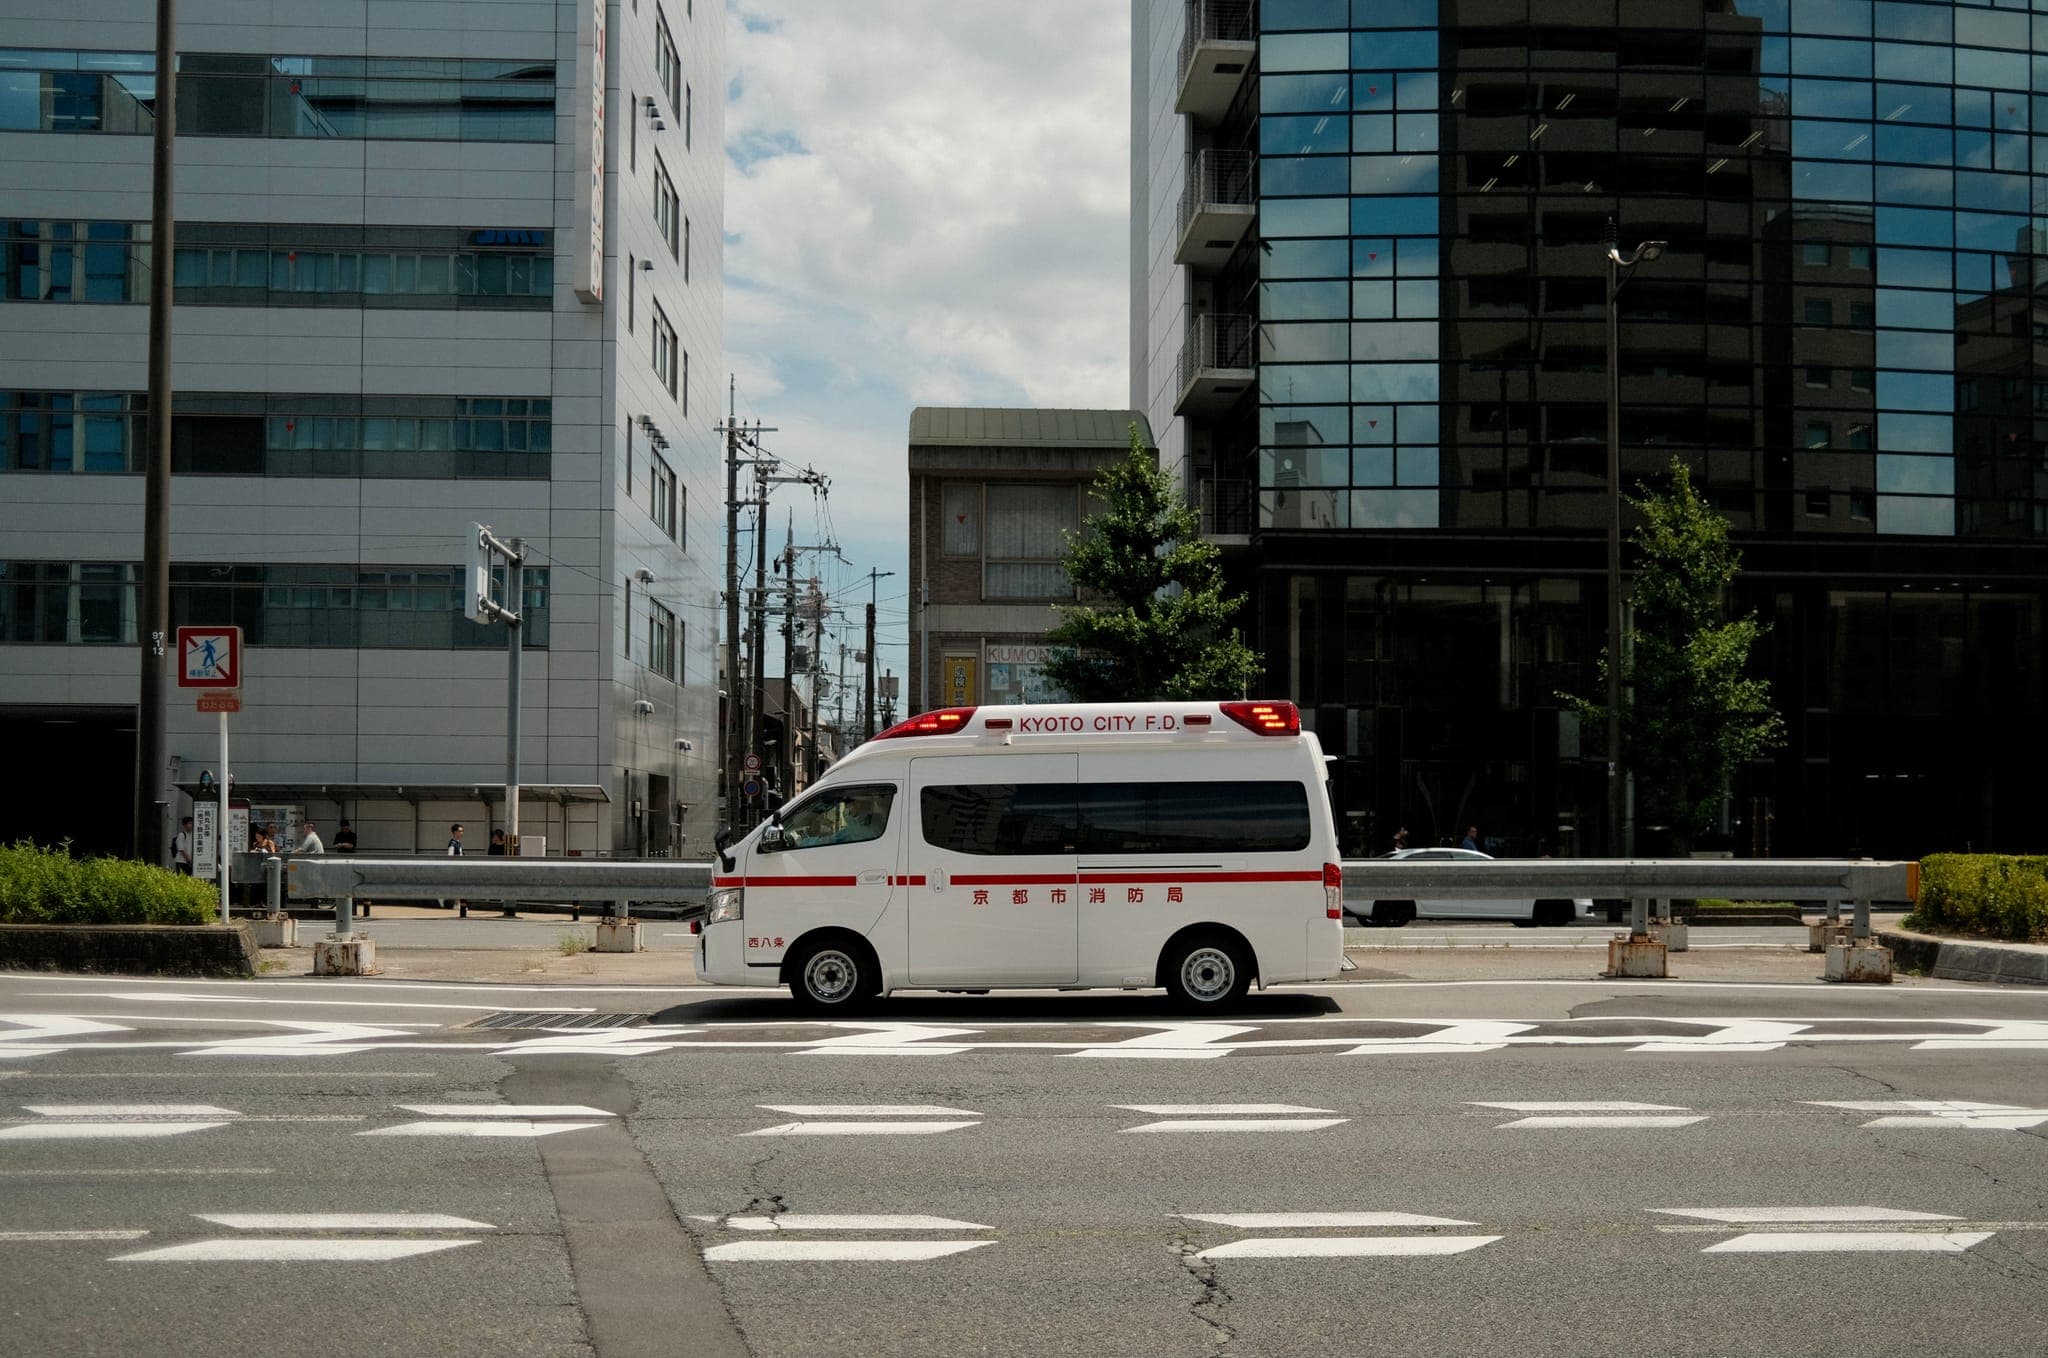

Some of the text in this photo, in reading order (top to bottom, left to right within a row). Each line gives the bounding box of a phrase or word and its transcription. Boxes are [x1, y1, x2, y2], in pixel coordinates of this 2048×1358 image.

[152, 632, 164, 640] 97
[152, 647, 164, 656] 12
[988, 647, 1049, 661] KUMON
[1020, 715, 1180, 732] KYOTO CITY F.D.
[973, 886, 1183, 905] 京都市消防局
[748, 937, 785, 948] 西八条
